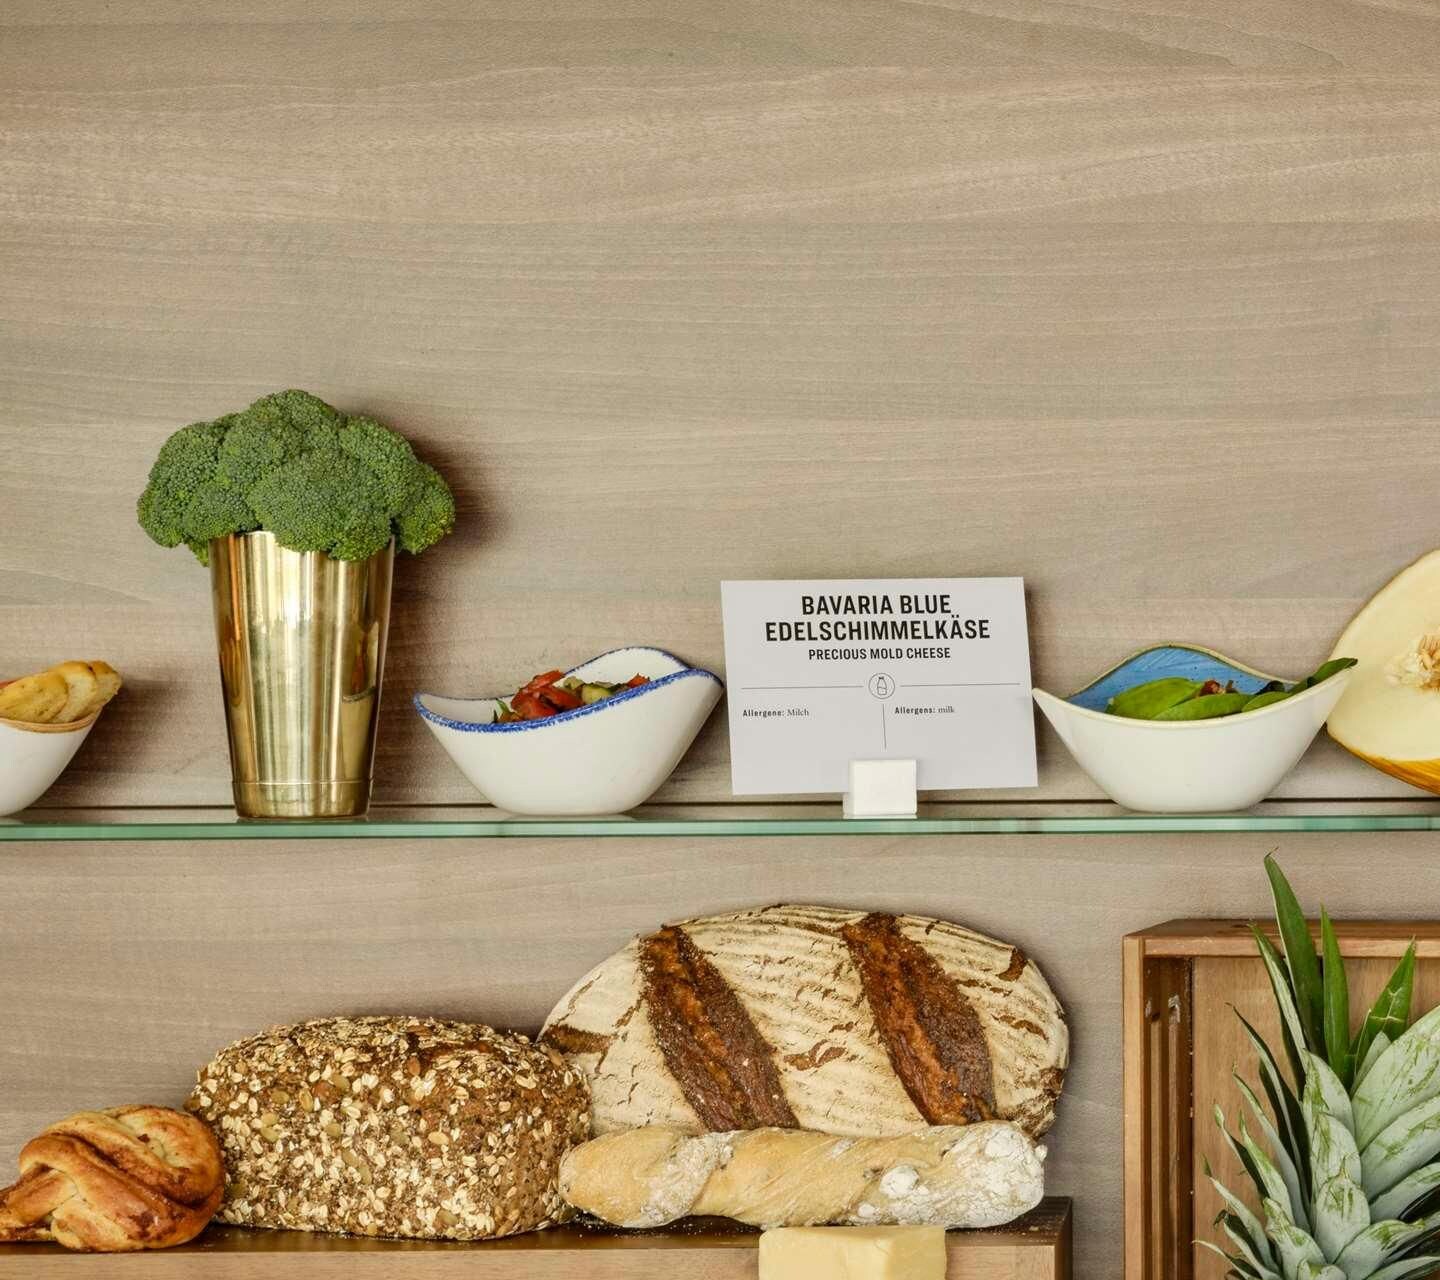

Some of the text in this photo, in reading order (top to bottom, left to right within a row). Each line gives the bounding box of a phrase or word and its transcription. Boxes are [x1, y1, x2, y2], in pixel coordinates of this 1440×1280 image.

[801, 594, 951, 615] BAVARIA BLUE
[765, 615, 990, 641] EDELSCHIMMELKÄSE
[808, 647, 951, 660] PRECIOUS MOLD CHEESE
[742, 708, 809, 718] Allergene: Milch
[894, 705, 954, 715] Allergens: milk
